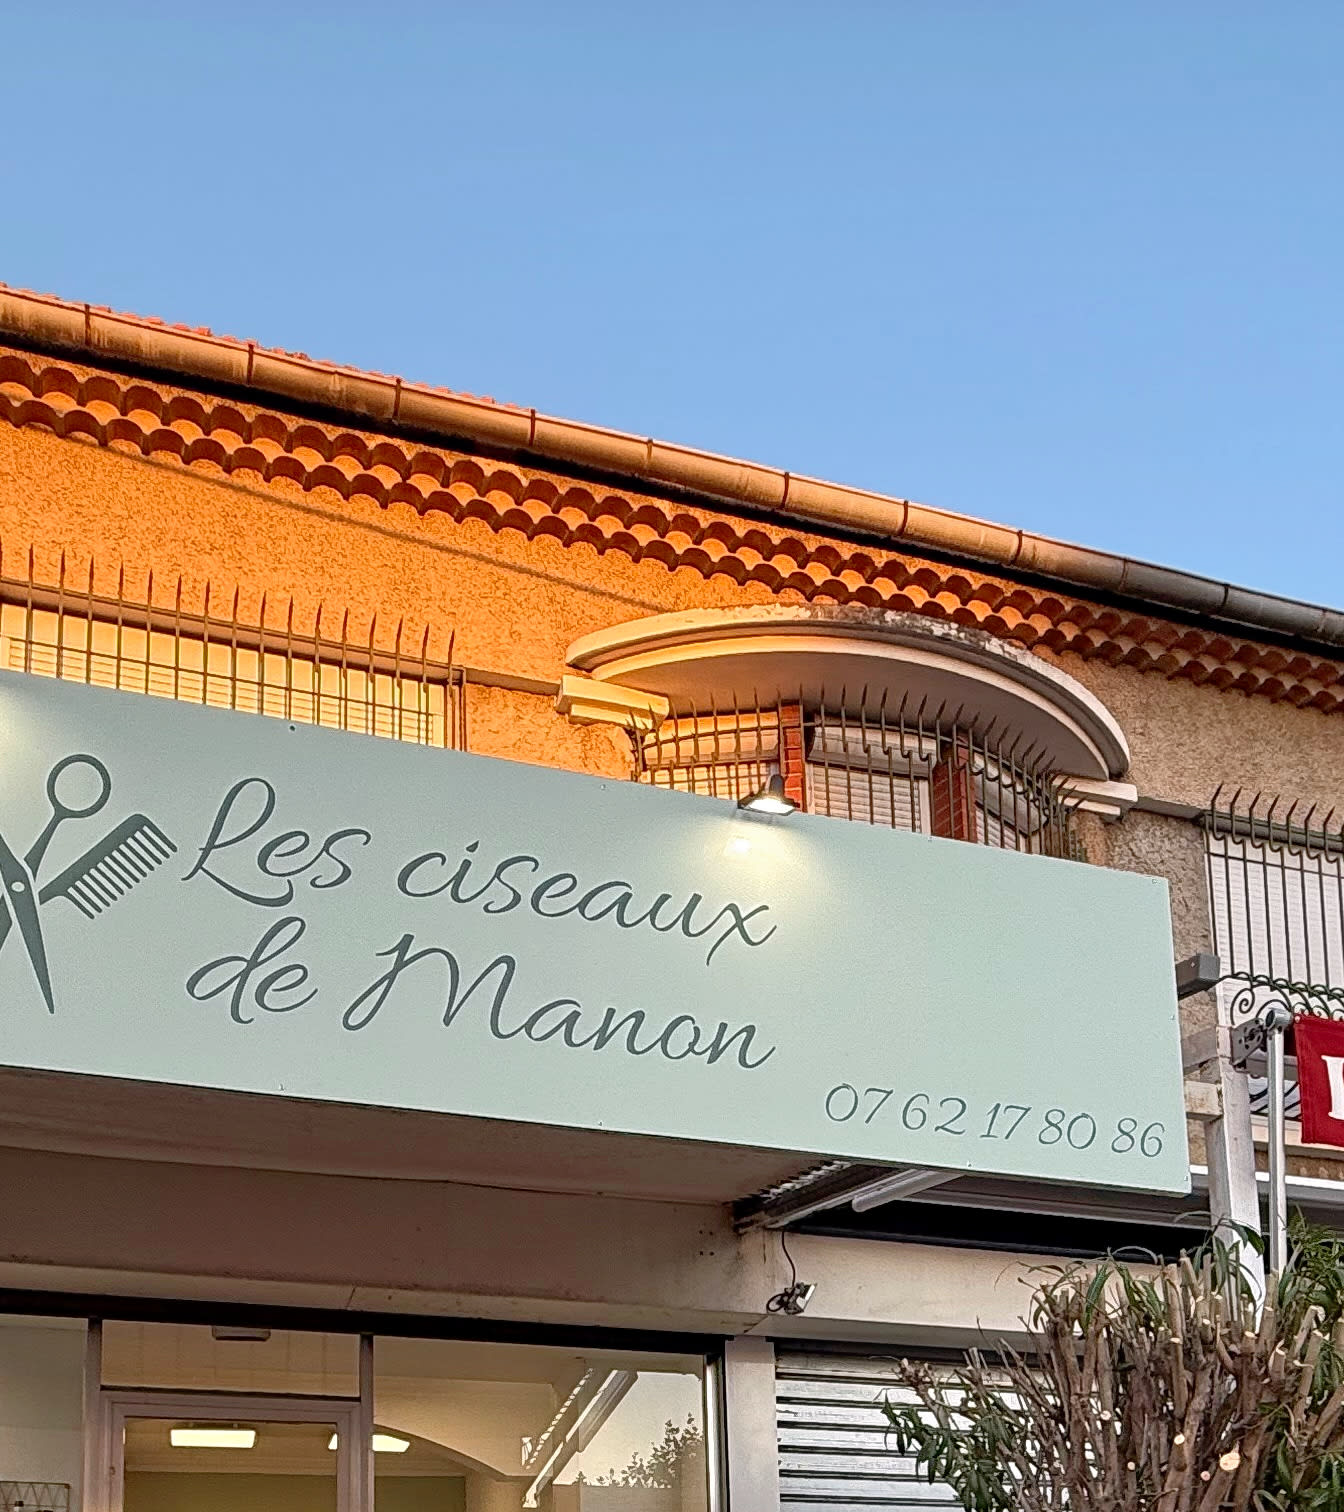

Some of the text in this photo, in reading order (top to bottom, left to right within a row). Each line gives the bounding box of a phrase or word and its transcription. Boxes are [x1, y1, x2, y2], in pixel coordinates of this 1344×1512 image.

[181, 777, 777, 966] Les ciseaux
[185, 916, 777, 1070] de Manon
[825, 1082, 1166, 1158] 07 62 17 80 86
